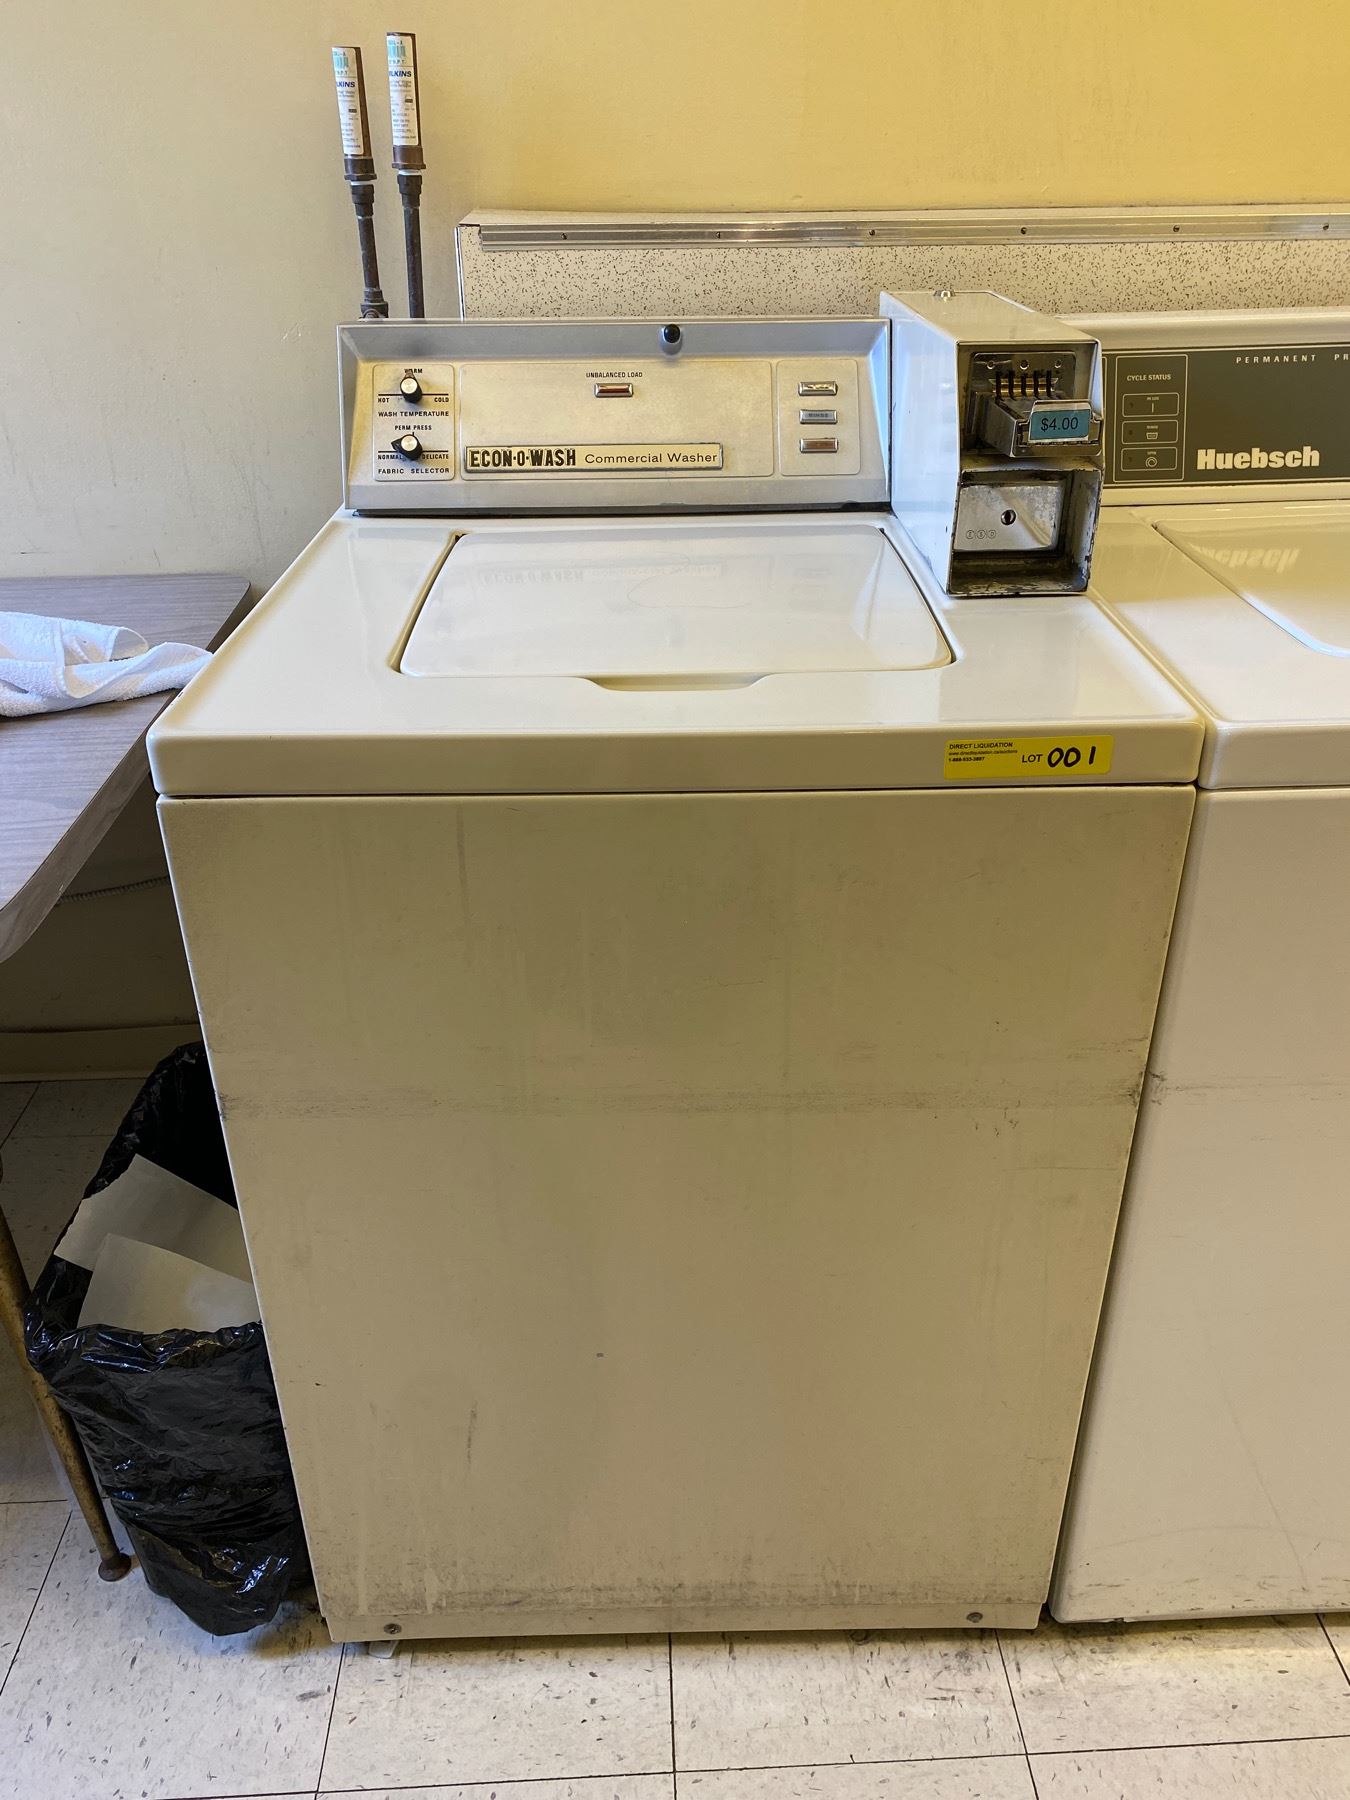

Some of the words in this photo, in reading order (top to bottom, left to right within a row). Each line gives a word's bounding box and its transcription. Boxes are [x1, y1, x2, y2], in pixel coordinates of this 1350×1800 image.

[1236, 354, 1317, 364] PERMANENT
[1148, 373, 1172, 381] STATUS
[1040, 416, 1079, 432] $4.00
[584, 453, 662, 464] Commercial
[667, 452, 718, 463] Washer
[1197, 446, 1320, 470] Huebsch
[1021, 754, 1043, 763] LOT
[1047, 746, 1096, 768] 001
